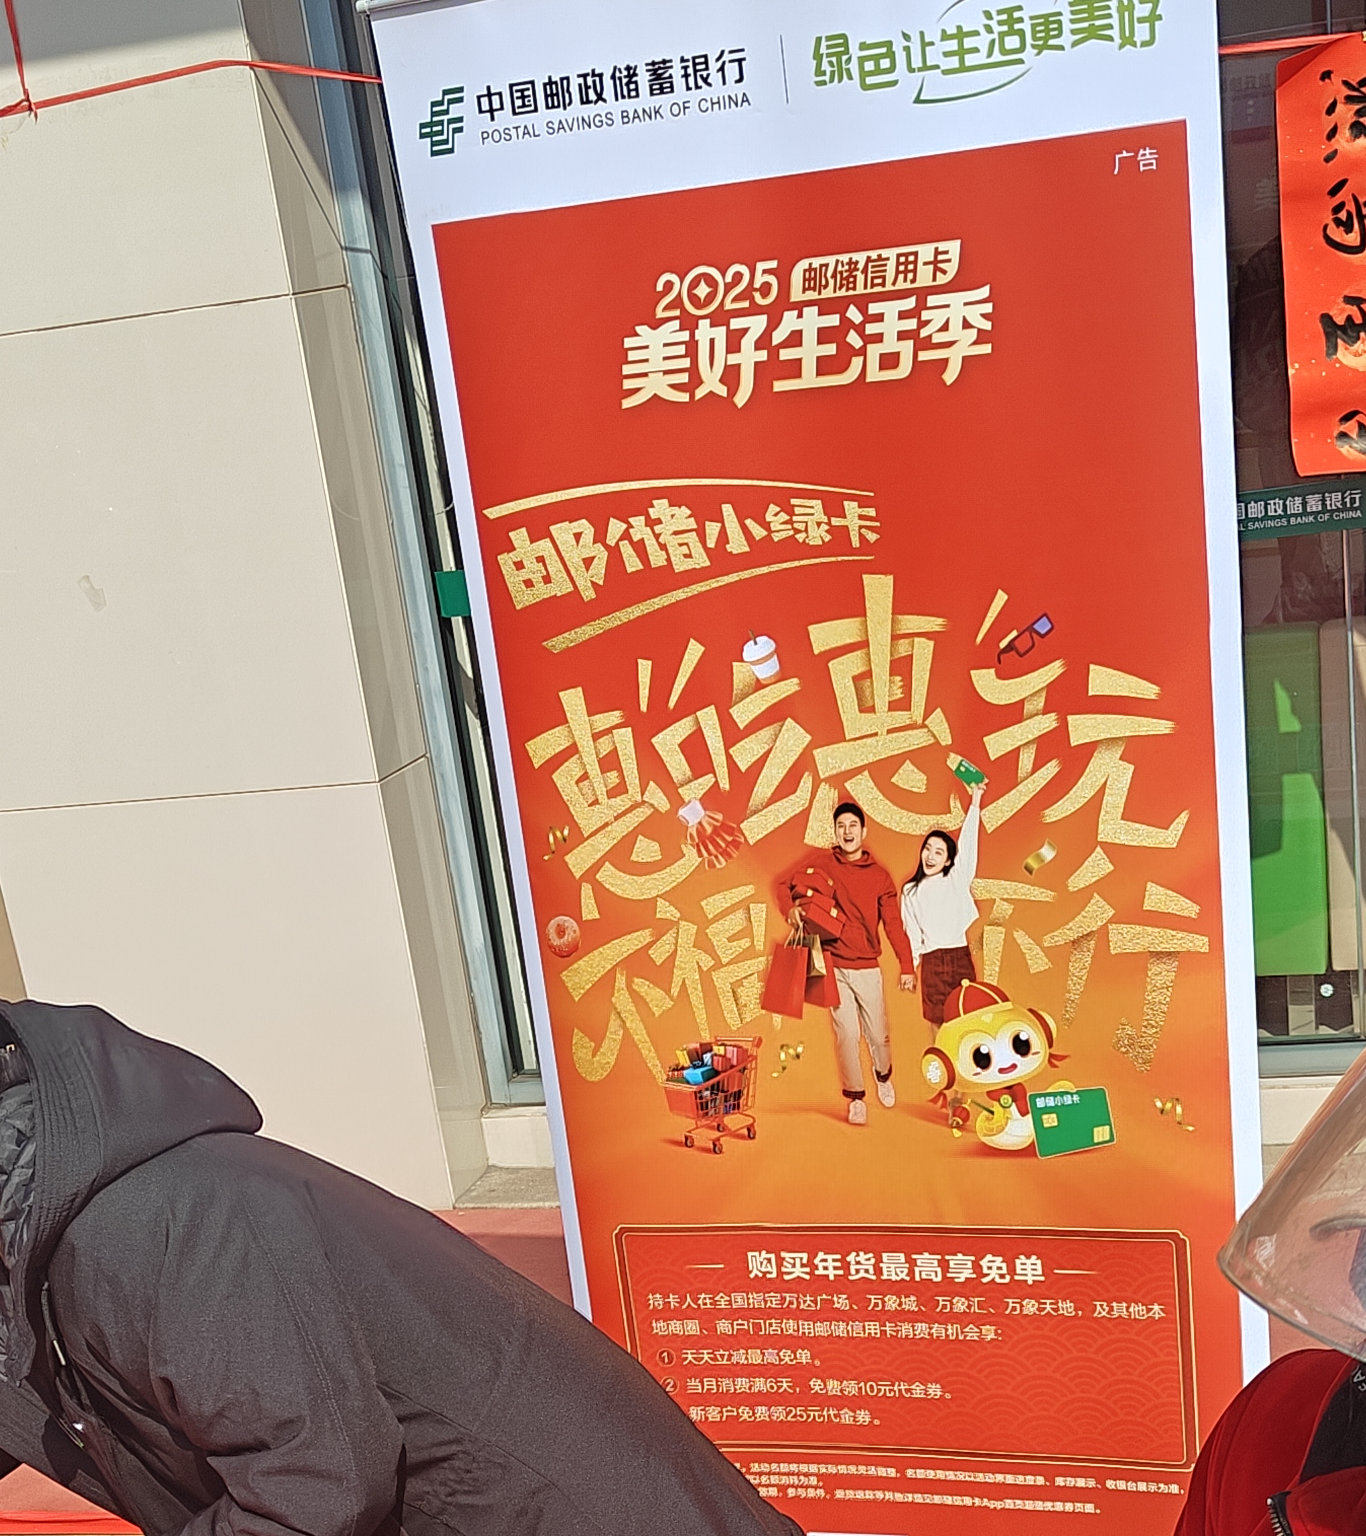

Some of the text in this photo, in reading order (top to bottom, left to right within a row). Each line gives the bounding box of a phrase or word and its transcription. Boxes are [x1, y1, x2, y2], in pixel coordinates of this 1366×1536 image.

[811, 0, 1163, 93] 绿色让生活更美好
[476, 47, 748, 121] 中国邮政储蓄银行
[480, 92, 752, 146] POSTAL SAVINGS BANK OF CHINA
[1113, 146, 1159, 176] 广告
[655, 259, 779, 319] 2025
[802, 246, 953, 296] 邮储信用卡
[621, 284, 994, 409] 美好生活季
[1247, 518, 1288, 530] SAVINGS
[1289, 515, 1315, 525] BANK
[1317, 512, 1331, 522] OF
[1332, 509, 1363, 520] CHINA
[495, 498, 881, 611] 邮储小绿卡
[524, 574, 1191, 921] 惠吃惠玩
[747, 1250, 1046, 1285] 购买年货最高享免单
[647, 1292, 1166, 1321] 持卡人在全国指定万达广场、万象城、万象汇、万象天地，及其他本
[681, 1349, 822, 1367] 天天立减最高免单。
[685, 1376, 953, 1401] 当月消费满6天，免费领10元代金券。
[688, 1405, 882, 1427] 新客户免费领25元代金券。
